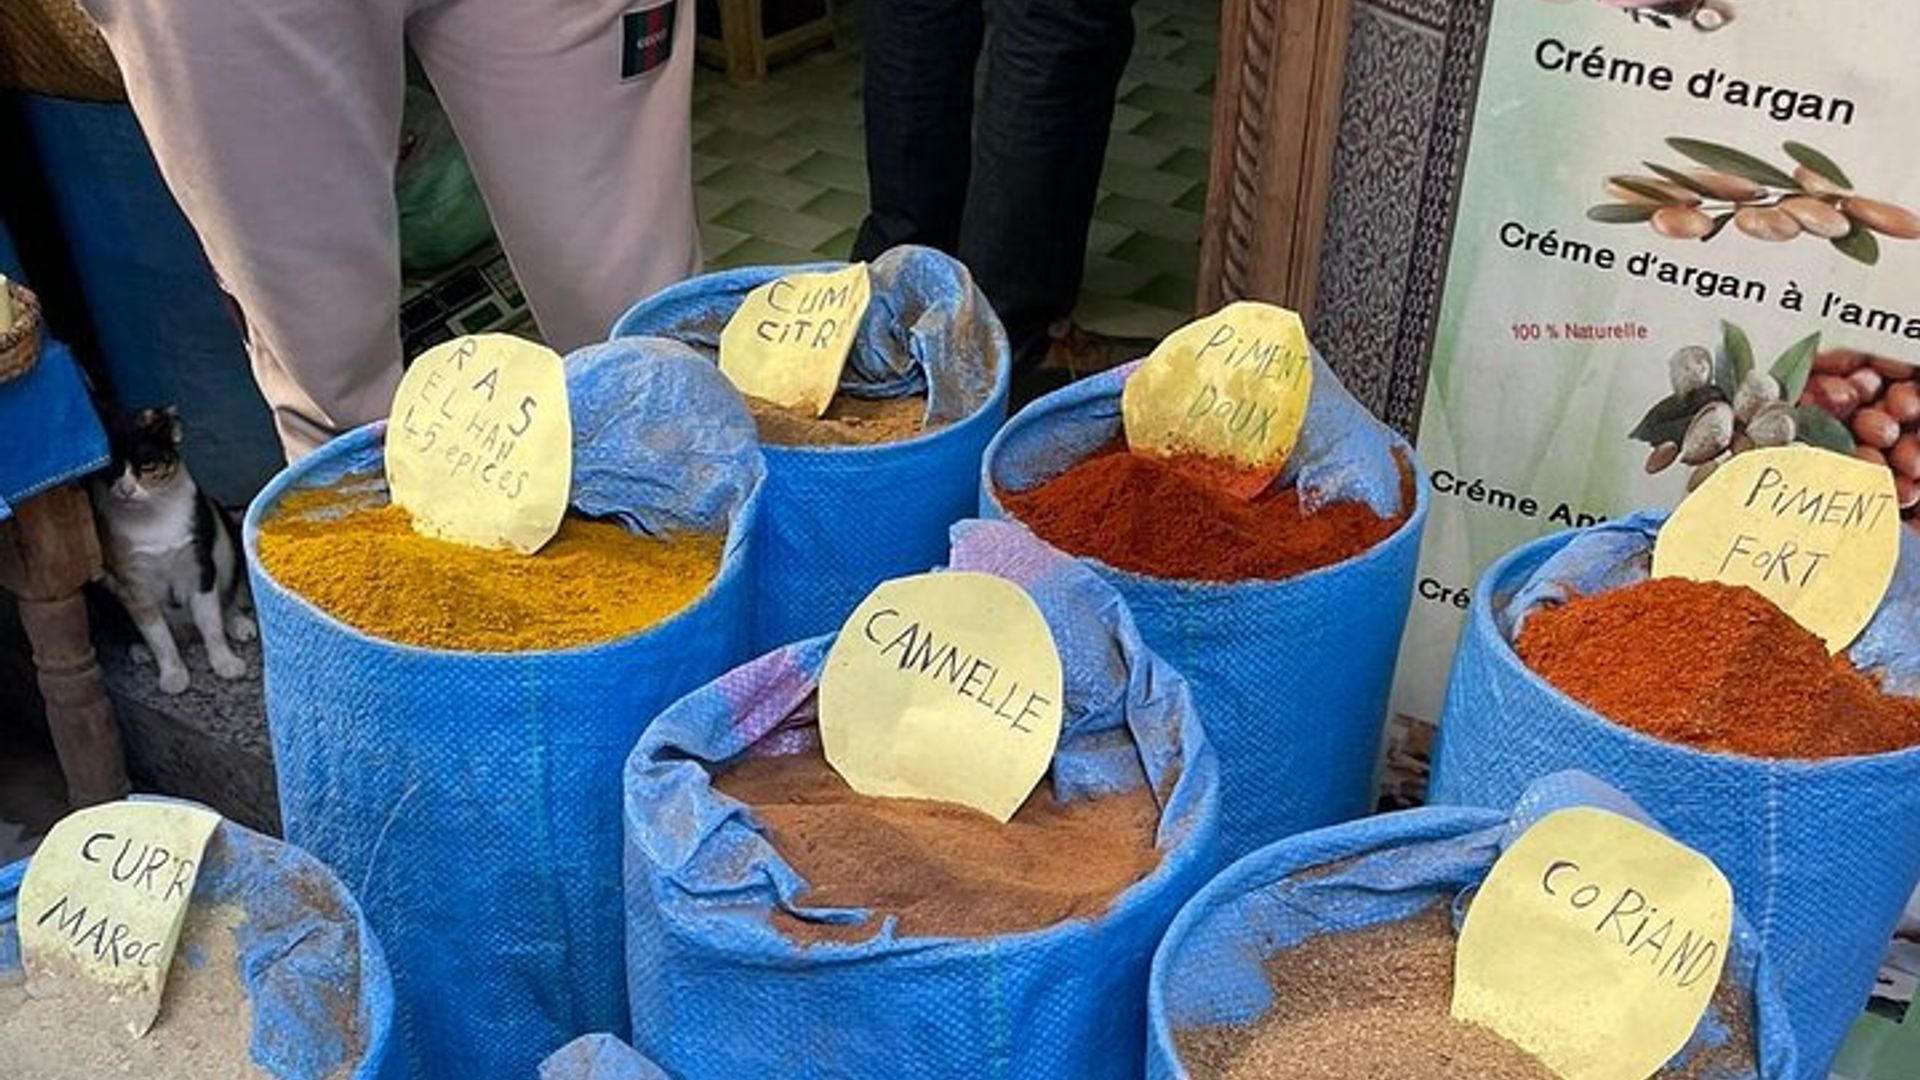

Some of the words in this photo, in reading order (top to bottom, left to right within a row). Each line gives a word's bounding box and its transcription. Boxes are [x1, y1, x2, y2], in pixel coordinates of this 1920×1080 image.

[1535, 38, 1673, 91] Créme
[1687, 68, 1855, 125] d'argan
[1500, 222, 1615, 269] Créme
[1627, 251, 1766, 303] d'argan
[1780, 280, 1802, 311] à
[1511, 323, 1541, 340] 100
[1546, 323, 1559, 339] %
[1565, 322, 1648, 340] Naturelle
[1429, 469, 1539, 516] Créme
[864, 608, 1052, 734] CANNELLE
